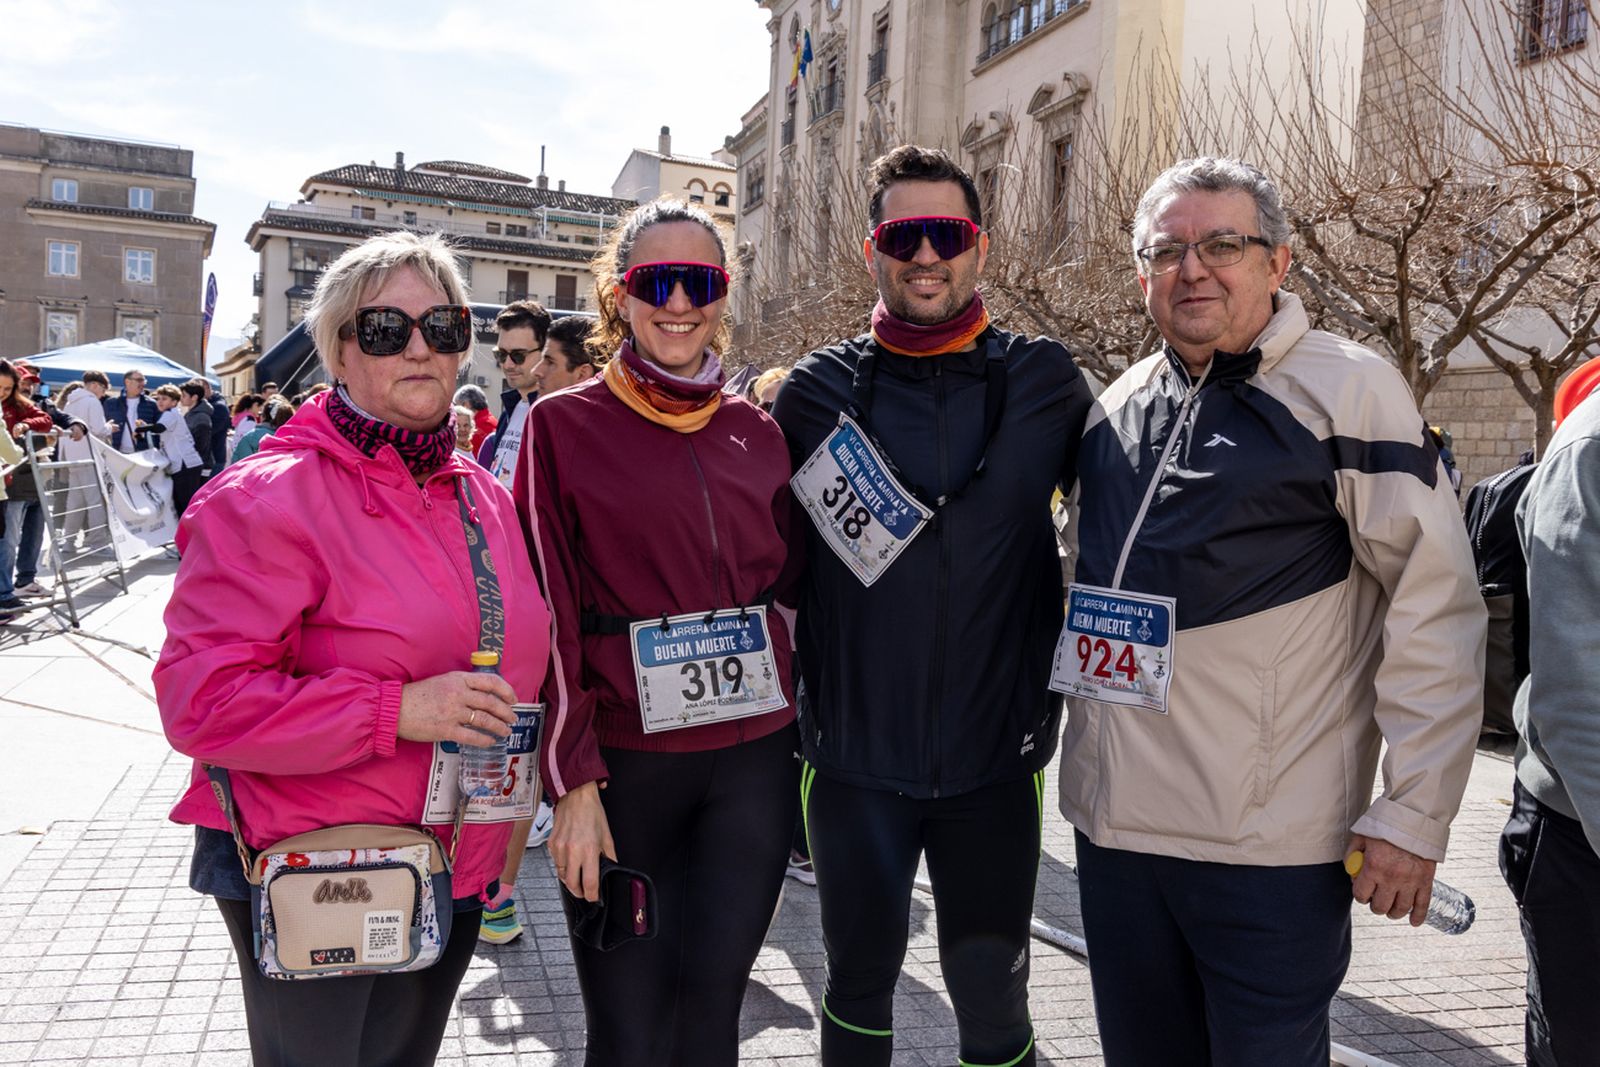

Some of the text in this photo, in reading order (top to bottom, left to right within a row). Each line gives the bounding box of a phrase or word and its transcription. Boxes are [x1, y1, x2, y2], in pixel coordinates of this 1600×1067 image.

[835, 443, 859, 478] BUENA
[853, 471, 886, 513] MUERTE
[853, 441, 878, 477] CARRERA
[874, 475, 909, 516] CAMINATA
[822, 475, 871, 540] 318
[652, 631, 663, 641] VI
[665, 623, 709, 639] CARRERA
[1094, 615, 1132, 637] MUERTE
[1109, 602, 1154, 619] CAMINATA
[654, 635, 737, 662] BUENA MUERTE
[1077, 635, 1138, 682] 924
[680, 656, 743, 702] 319
